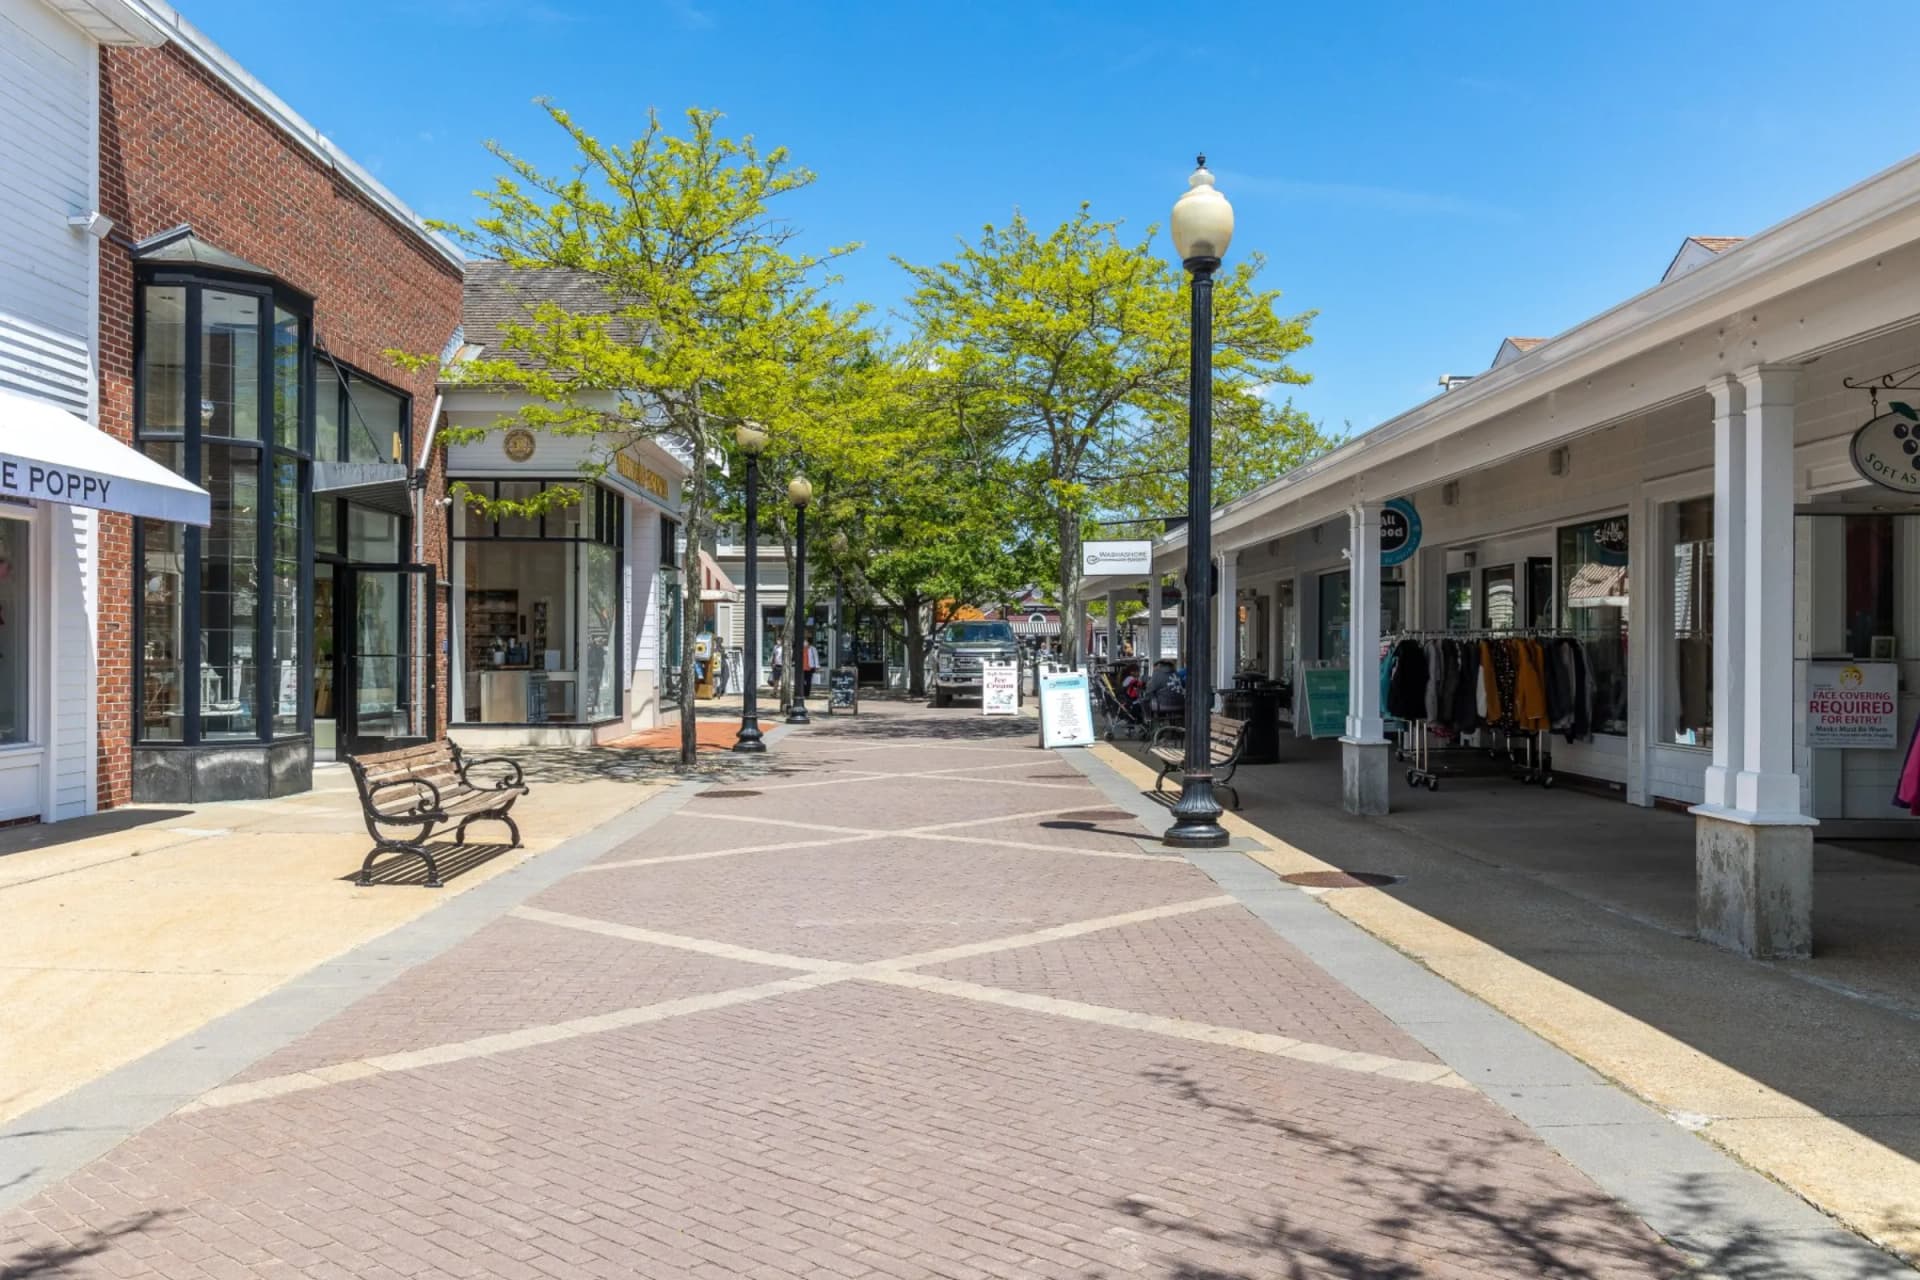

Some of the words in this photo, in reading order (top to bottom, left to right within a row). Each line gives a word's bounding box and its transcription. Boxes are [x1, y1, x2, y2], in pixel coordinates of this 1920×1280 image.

[1865, 453, 1896, 479] SOFT
[1901, 472, 1917, 484] AS
[2, 461, 18, 490] E
[30, 466, 111, 503] POPPY
[1381, 527, 1404, 537] ood
[1813, 691, 1837, 700] FACE
[1839, 691, 1891, 700] COVERING
[1809, 700, 1894, 714] REQUIRED
[1821, 715, 1842, 724] FOR
[1845, 715, 1882, 724] ENTRY!
